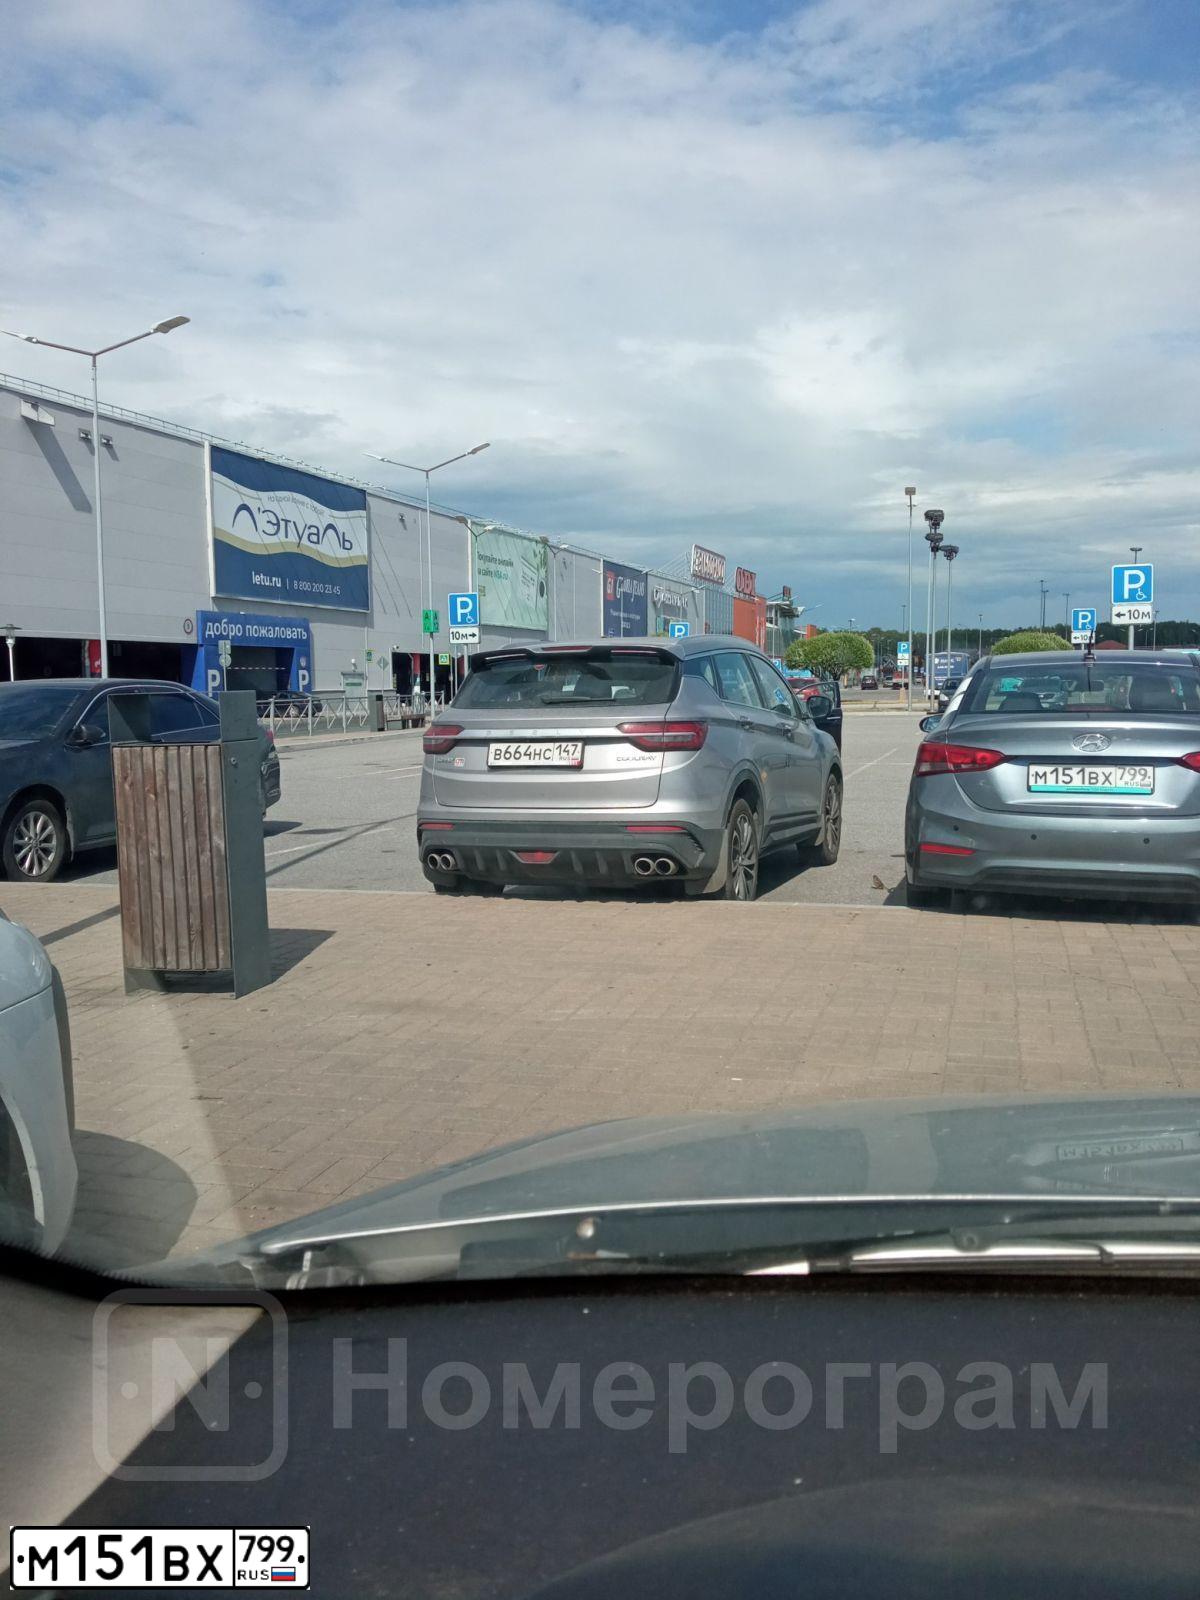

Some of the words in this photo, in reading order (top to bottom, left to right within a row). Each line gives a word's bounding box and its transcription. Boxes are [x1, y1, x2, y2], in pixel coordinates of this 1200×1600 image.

[252, 571, 281, 588] letu.ru
[312, 582, 324, 592] 200
[334, 586, 340, 595] 45
[1123, 570, 1146, 600] P
[456, 596, 472, 622] P
[206, 619, 242, 639] добро
[246, 624, 308, 640] пожаловать
[1078, 612, 1092, 628] P
[674, 625, 686, 637] P
[900, 643, 908, 652] P
[208, 670, 220, 698] P
[298, 670, 309, 692] P
[493, 745, 552, 760] В664НС
[556, 744, 578, 756] 147
[1034, 768, 1112, 785] М151ВХ
[1118, 768, 1148, 781] 799
